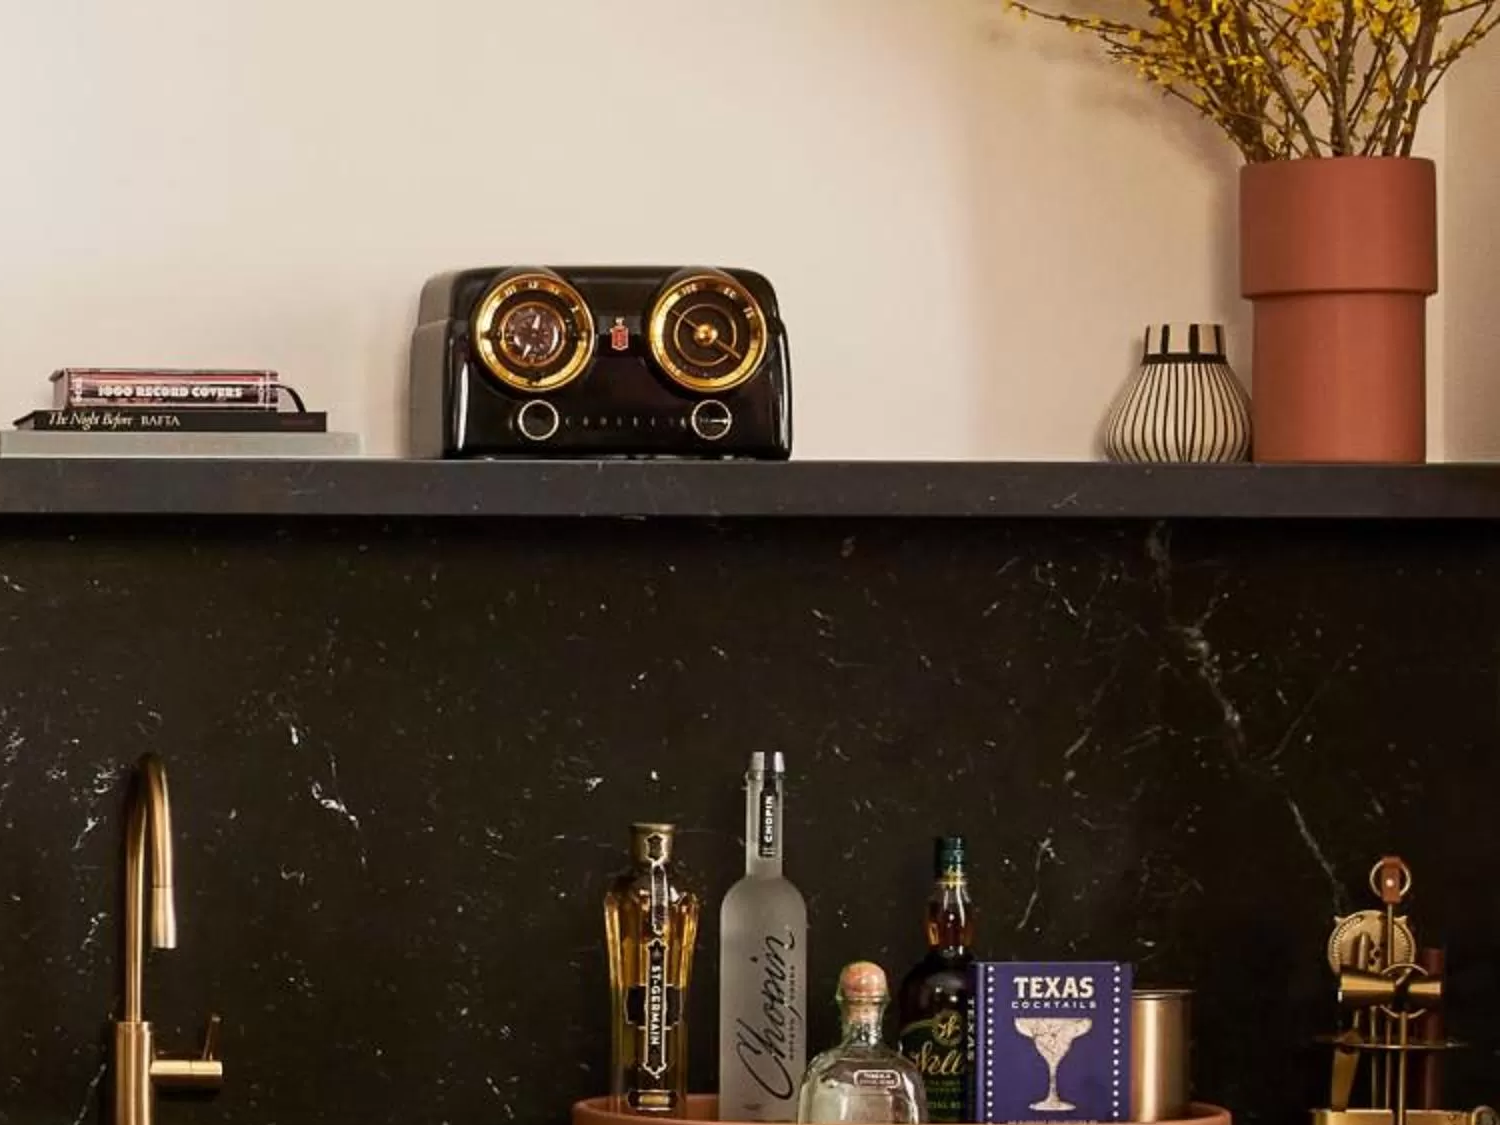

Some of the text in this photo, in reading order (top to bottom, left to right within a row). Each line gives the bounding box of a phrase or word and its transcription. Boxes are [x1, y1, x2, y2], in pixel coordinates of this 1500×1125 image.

[135, 385, 189, 397] RECORD
[191, 386, 243, 398] COVERS
[49, 411, 181, 430] The Night Before BAFTA
[764, 795, 773, 843] CHOPIN
[1013, 976, 1095, 998] TEXAS
[651, 965, 661, 1046] ST-GERMAIN
[736, 931, 802, 1100] Chopin
[1011, 1001, 1097, 1009] COCKTAILS
